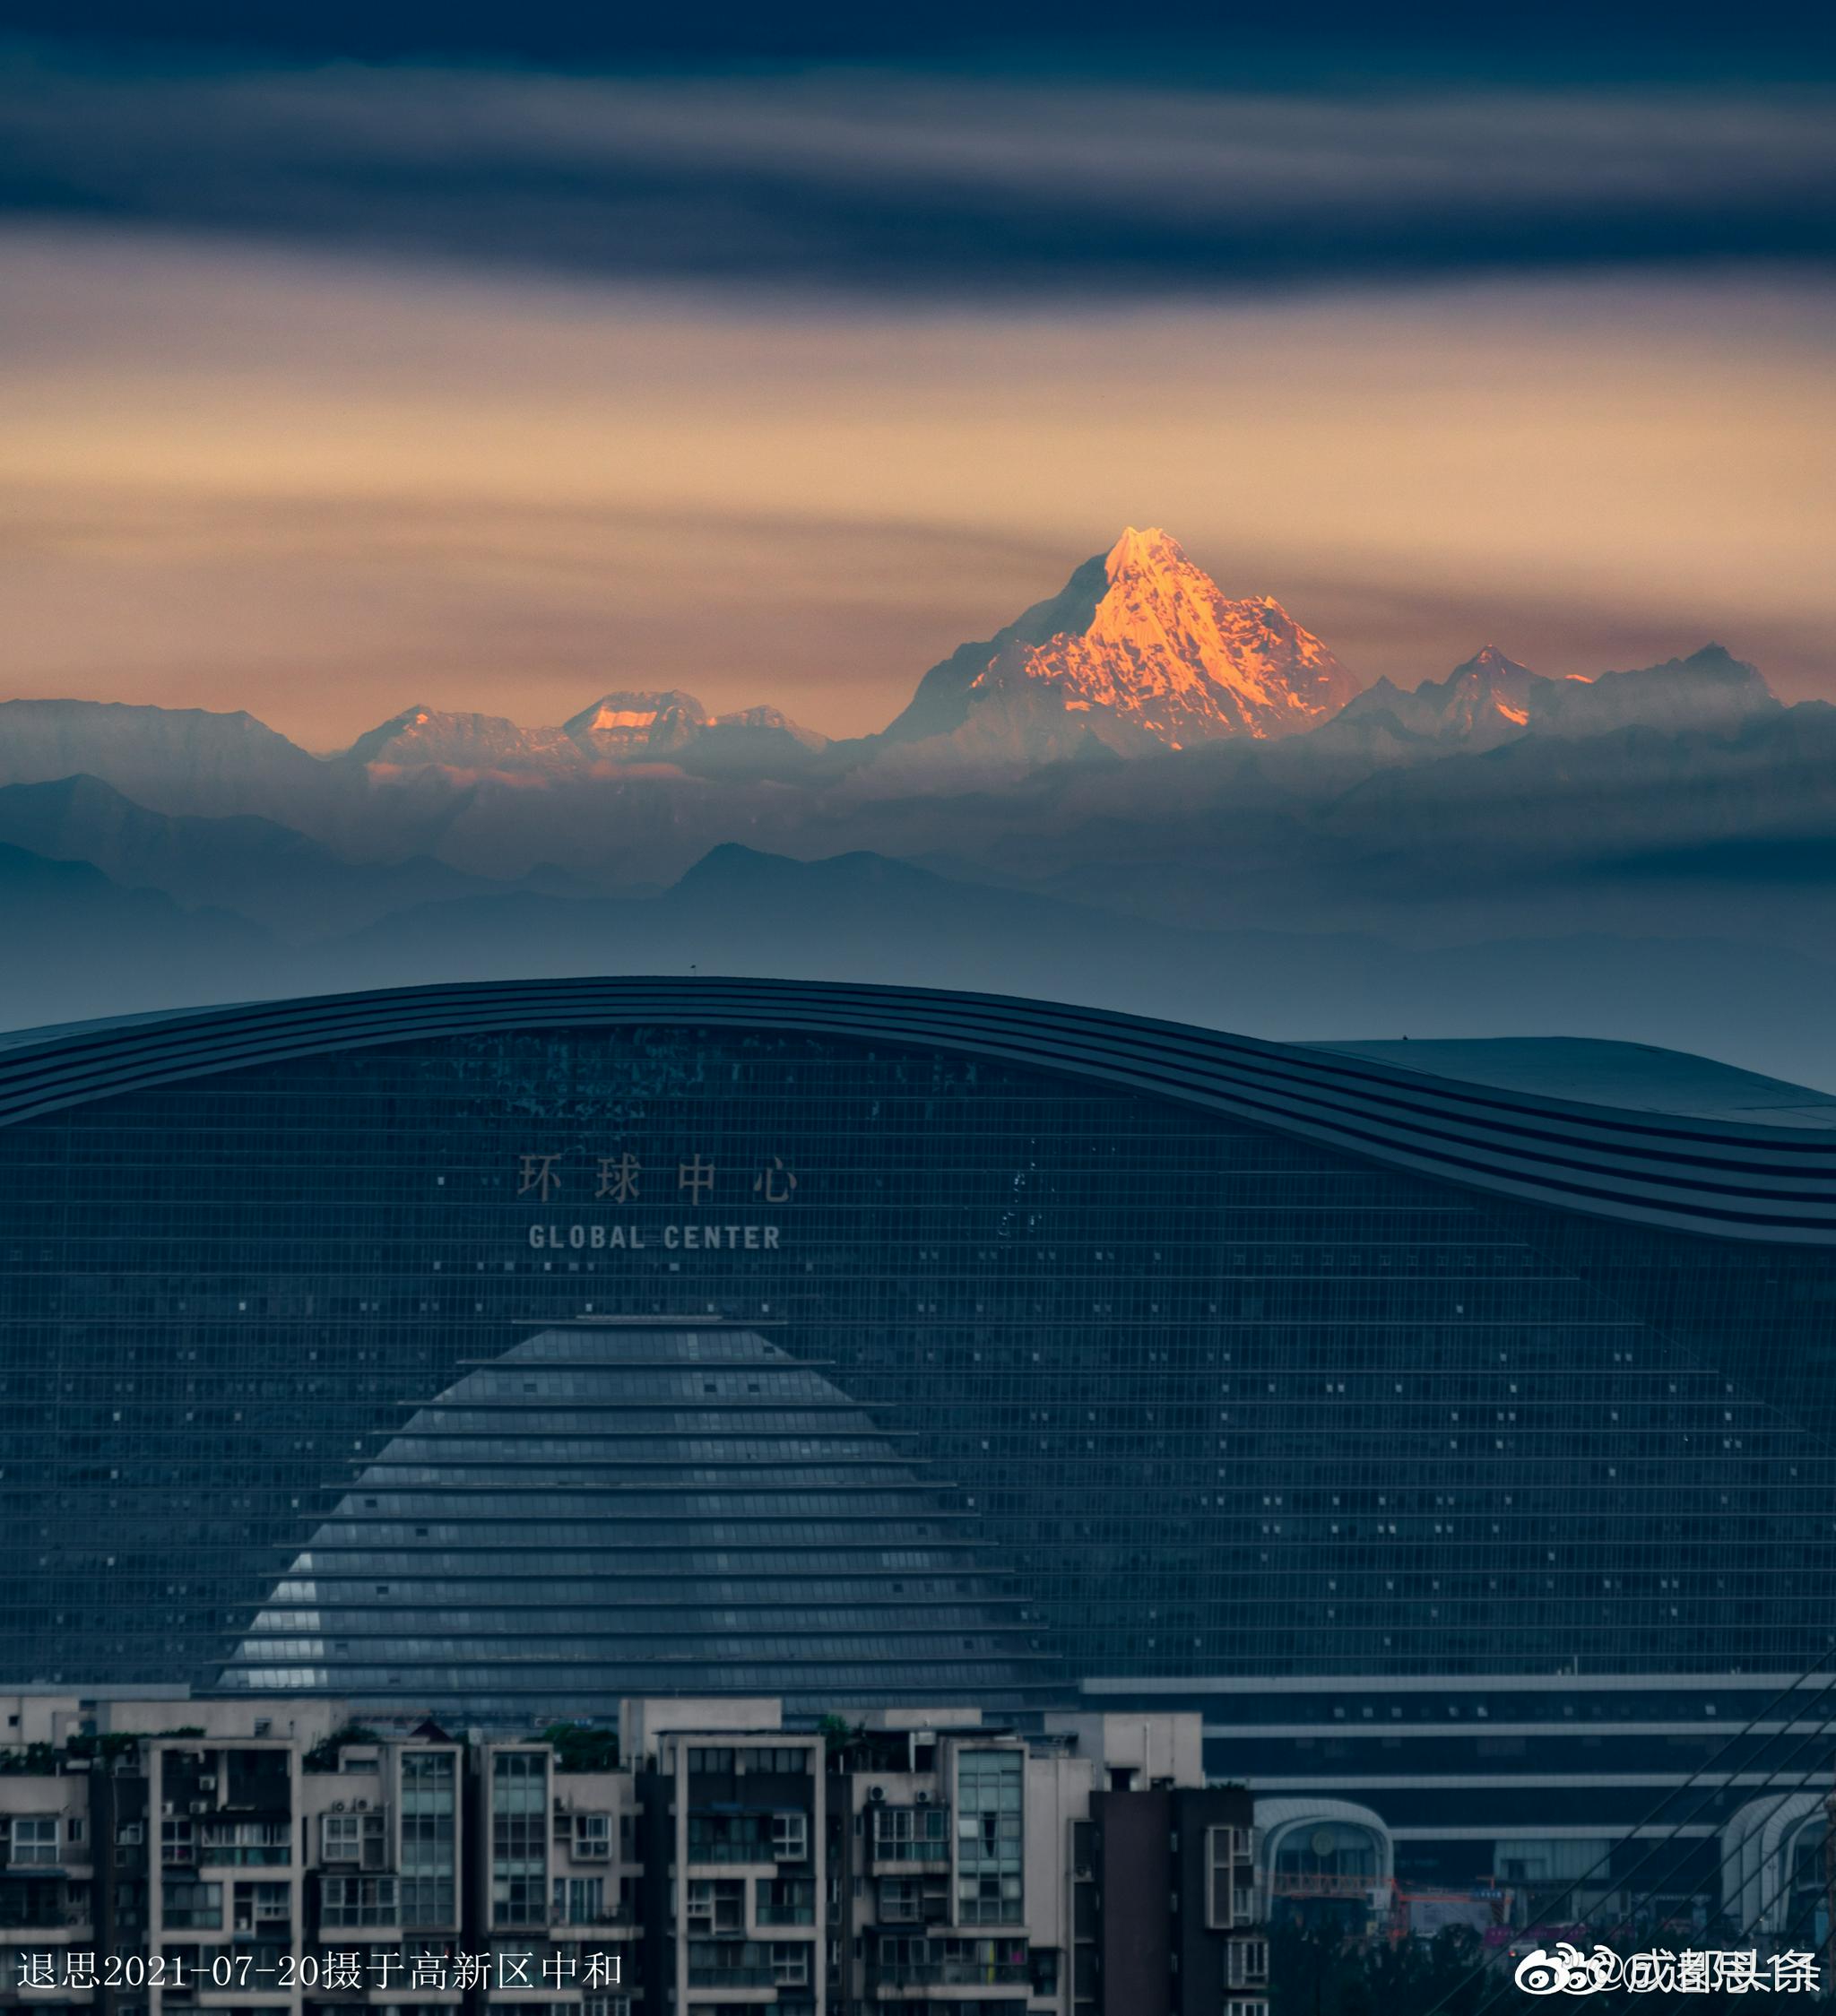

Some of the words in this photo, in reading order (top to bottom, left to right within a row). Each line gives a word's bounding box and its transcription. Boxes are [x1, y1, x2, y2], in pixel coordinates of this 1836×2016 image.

[516, 1153, 797, 1206] 环球中心
[529, 1224, 645, 1249] GLOBAL
[663, 1225, 780, 1250] CENTER
